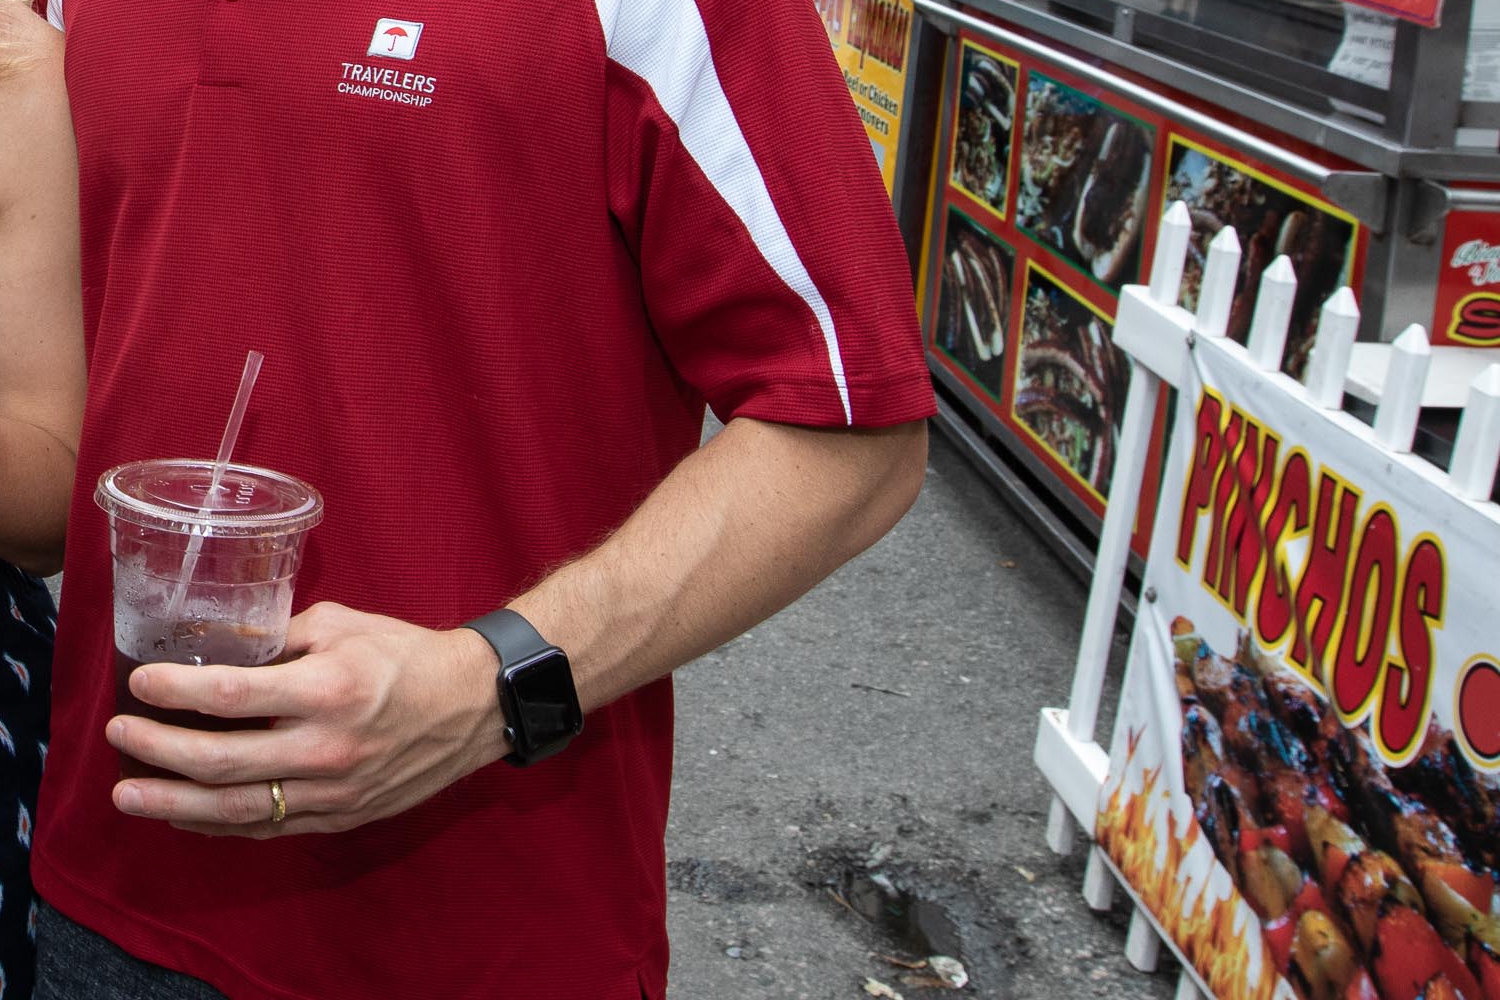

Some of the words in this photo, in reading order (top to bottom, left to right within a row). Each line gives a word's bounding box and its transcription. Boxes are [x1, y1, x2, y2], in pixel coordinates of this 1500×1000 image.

[341, 62, 437, 94] TRAVELERS
[337, 82, 432, 107] CHAMPIONSHIP
[868, 83, 899, 116] Chicken
[1174, 385, 1450, 766] PINCHOS
